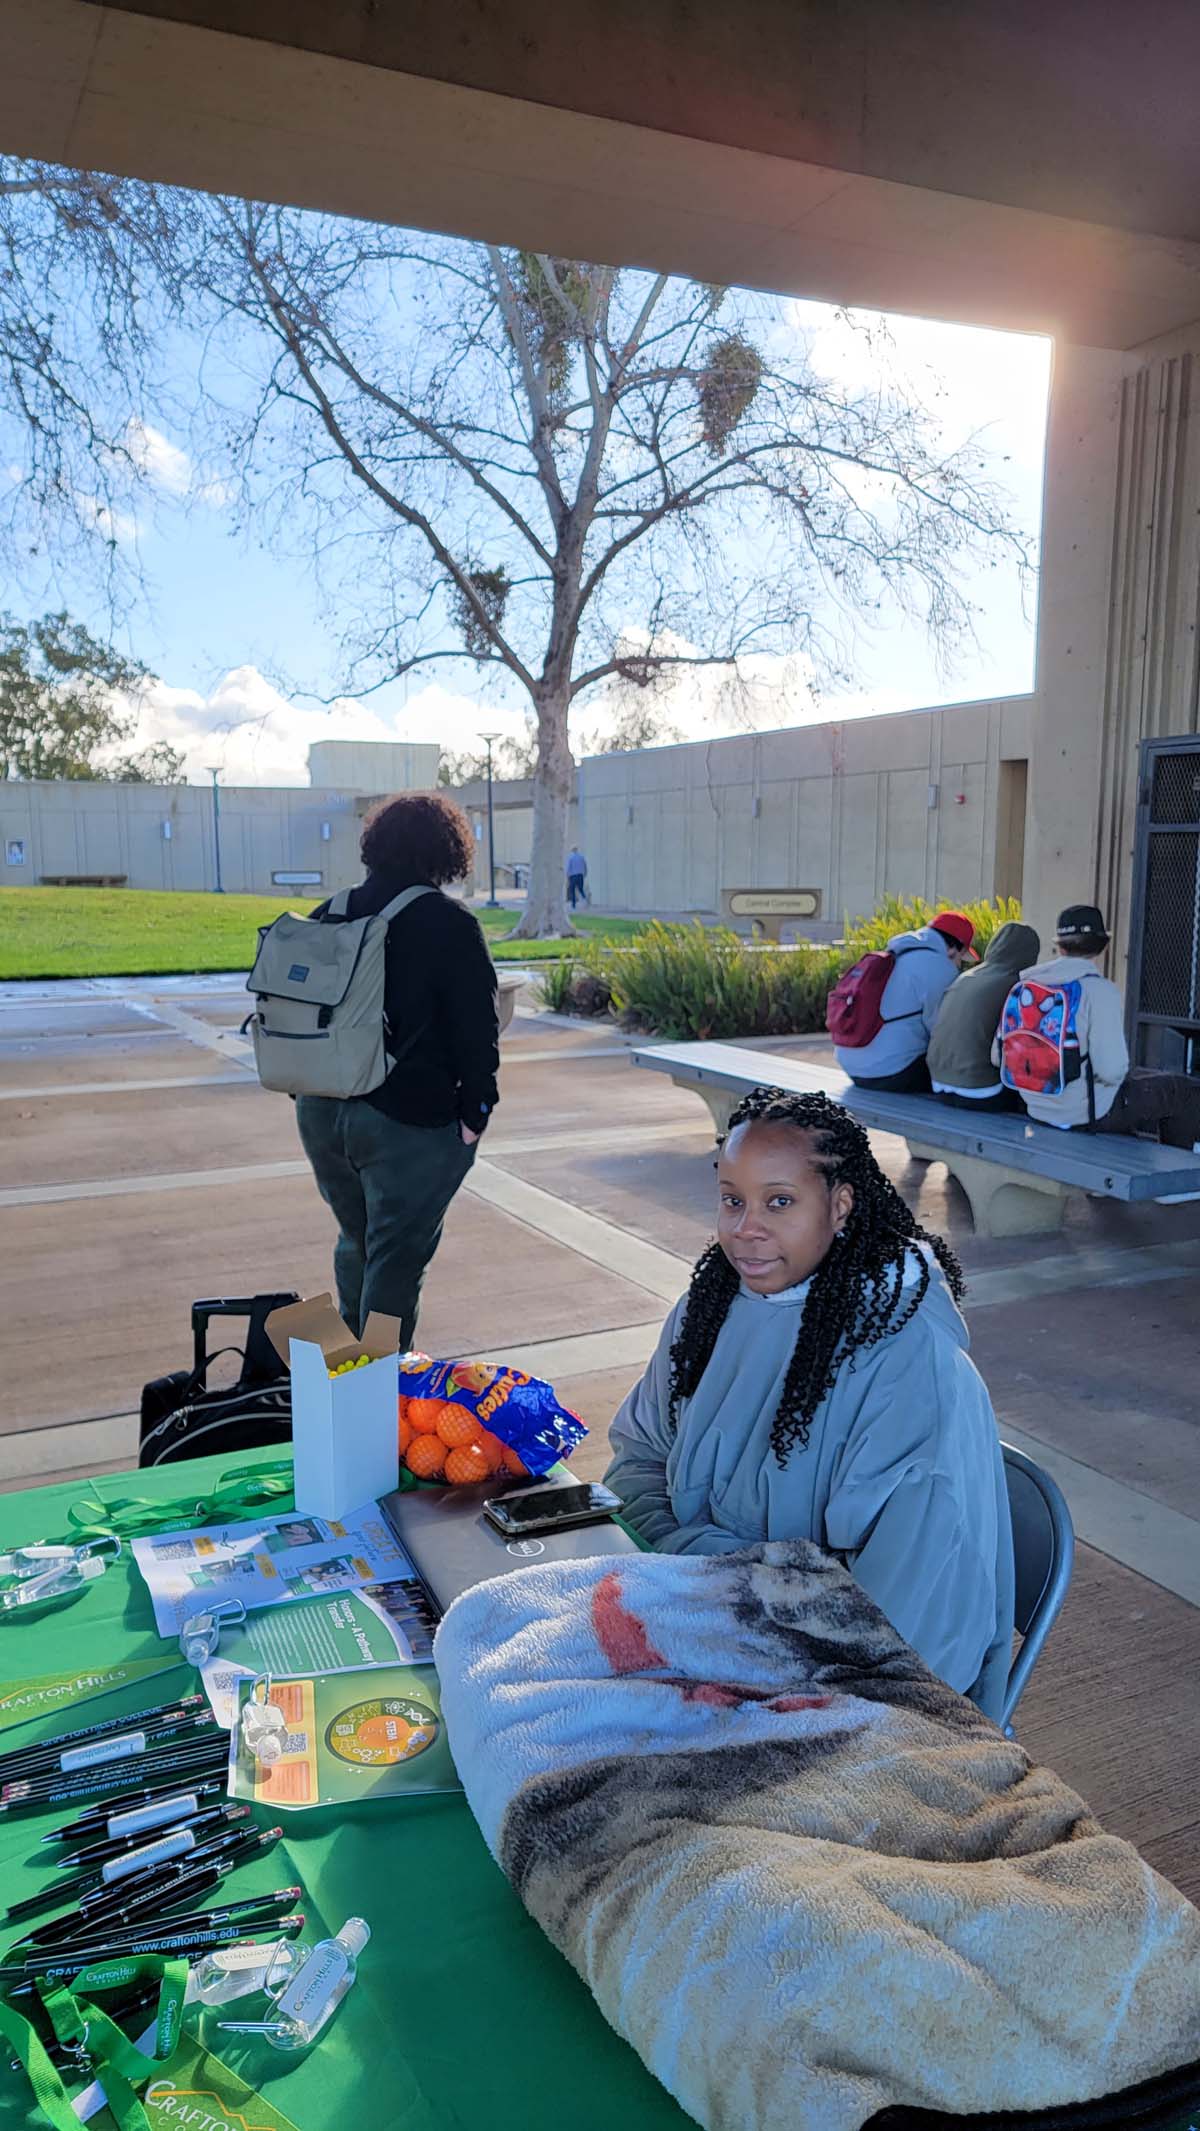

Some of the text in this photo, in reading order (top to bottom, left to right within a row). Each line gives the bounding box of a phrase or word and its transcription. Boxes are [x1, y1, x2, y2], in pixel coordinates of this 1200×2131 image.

[476, 1367, 532, 1422] Cuties
[326, 1601, 346, 1629] Transfer
[339, 1599, 356, 1623] Honors
[0, 1670, 127, 1710] RAFTON HILLS
[132, 1927, 240, 1954] www.craftonhills.edu
